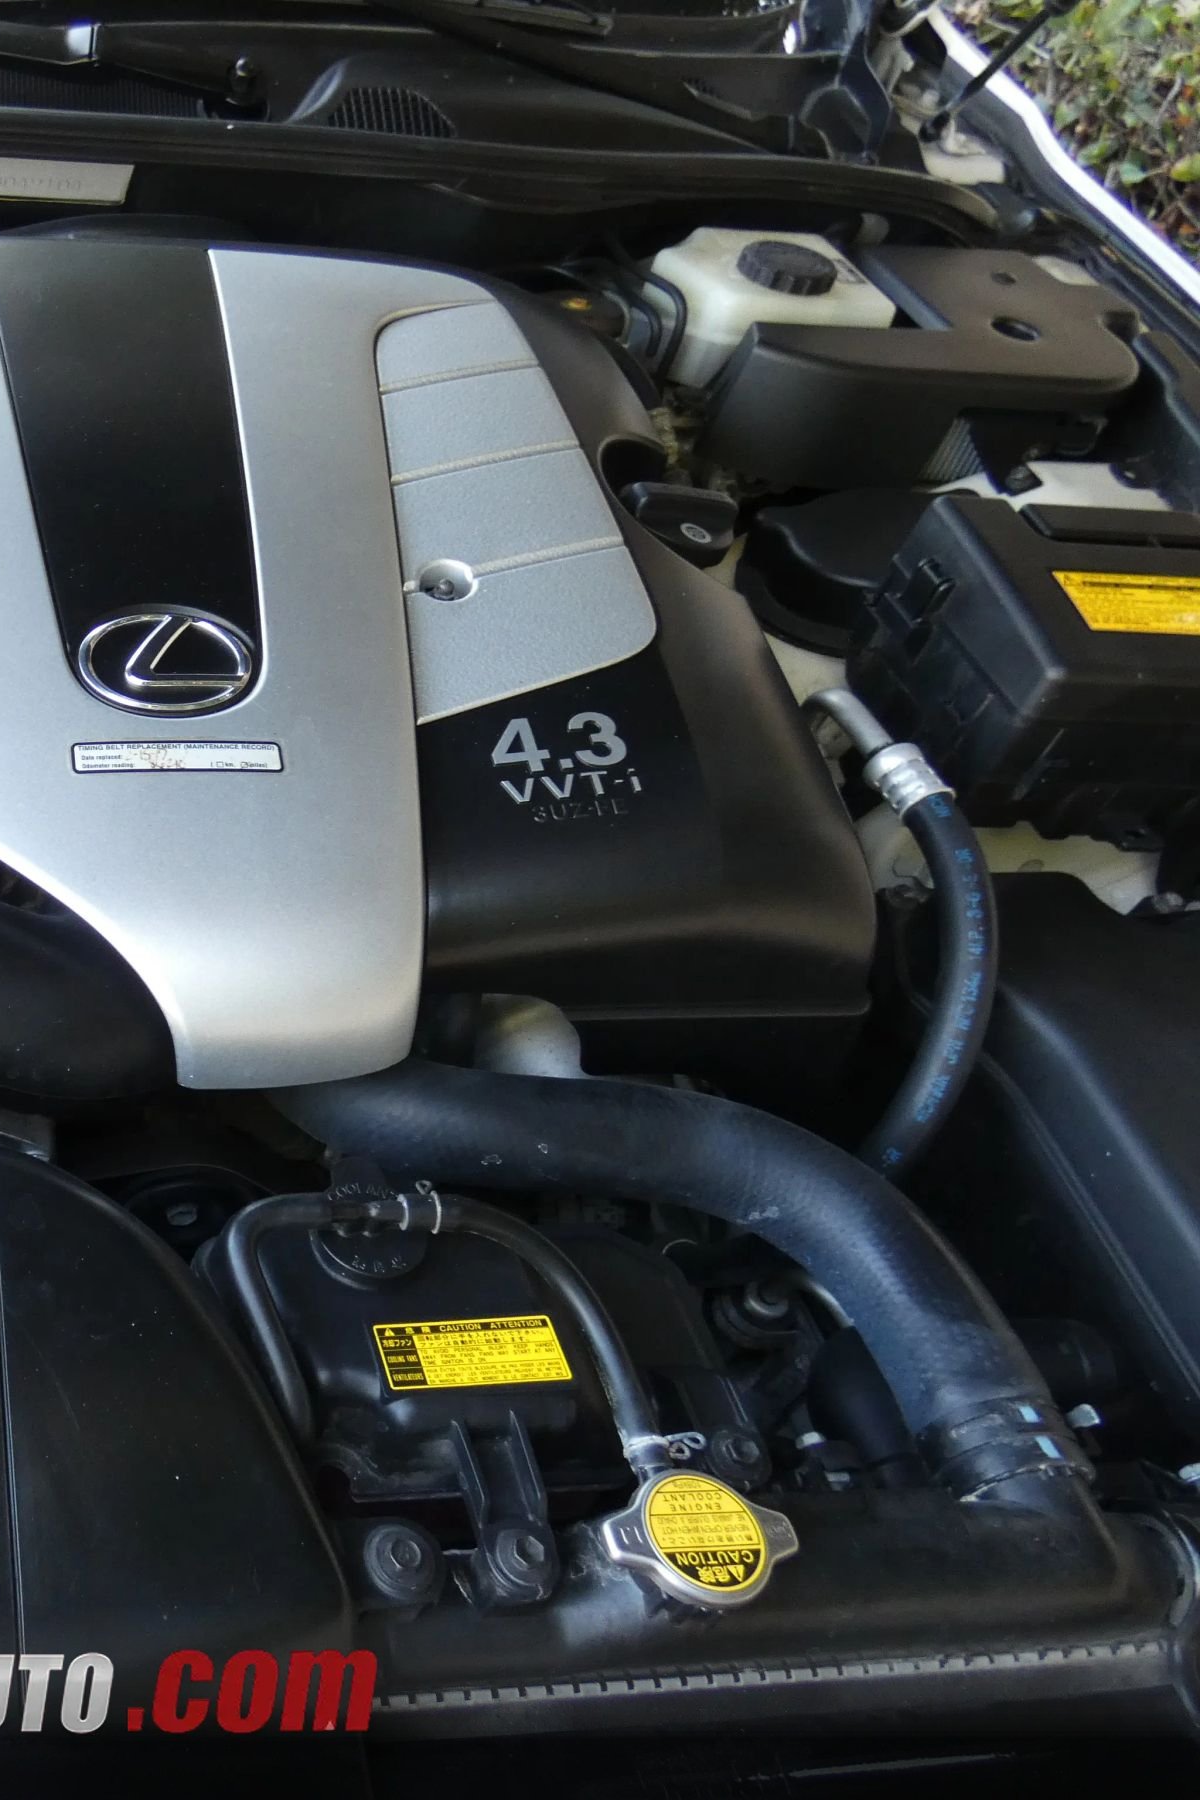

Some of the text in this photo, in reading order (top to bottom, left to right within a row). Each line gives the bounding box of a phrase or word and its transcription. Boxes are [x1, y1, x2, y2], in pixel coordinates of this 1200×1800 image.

[491, 711, 627, 774] 4.3
[500, 768, 642, 804] VVT-i
[439, 1319, 543, 1333] CAUTION ATTENTION
[662, 1491, 723, 1503] COOLANT
[669, 1502, 722, 1513] ENGINE
[662, 1524, 750, 1535] NEVER OPEN WHEN HOT
[675, 1550, 755, 1566] CAUTION
[696, 1565, 730, 1583] 危険
